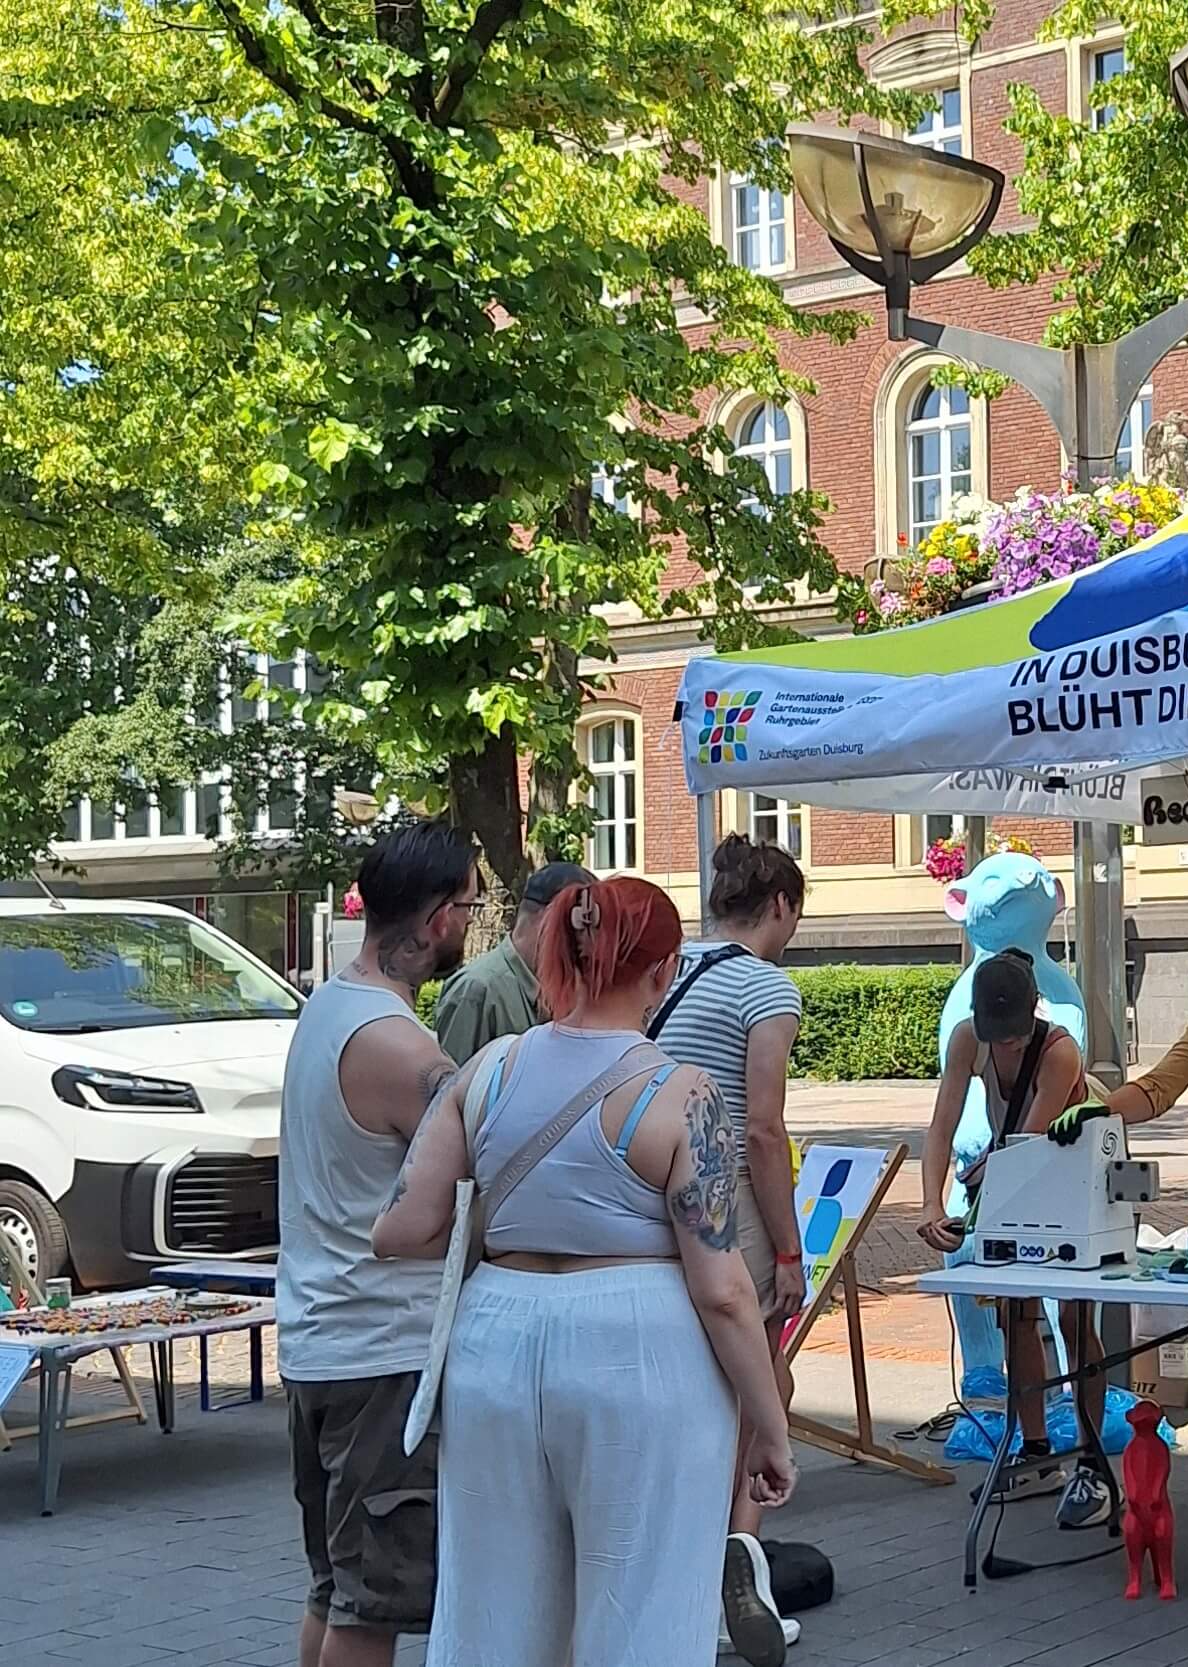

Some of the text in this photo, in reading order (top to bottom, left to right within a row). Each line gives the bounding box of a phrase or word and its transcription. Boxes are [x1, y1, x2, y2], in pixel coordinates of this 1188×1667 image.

[1010, 657, 1056, 687] IN
[775, 691, 845, 703] Internationale
[1008, 684, 1153, 736] BLÜHT
[823, 742, 864, 756] Duisburg
